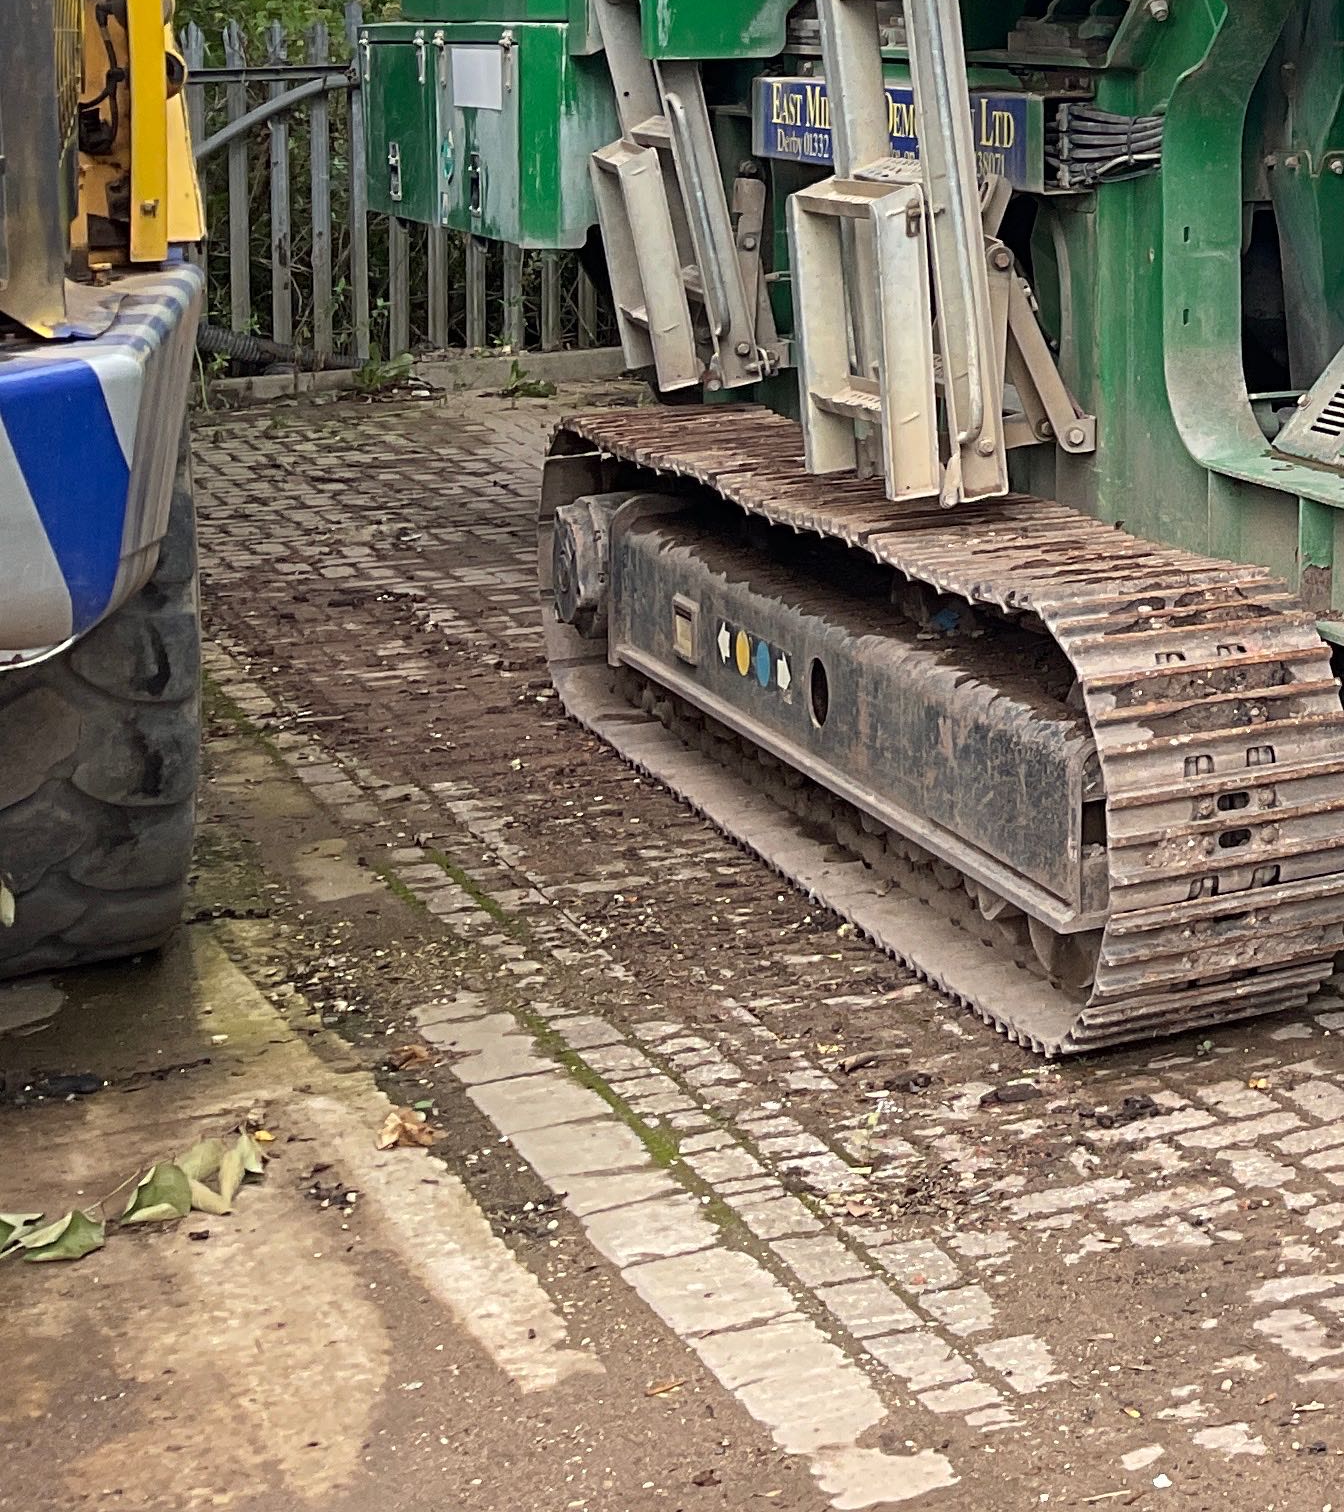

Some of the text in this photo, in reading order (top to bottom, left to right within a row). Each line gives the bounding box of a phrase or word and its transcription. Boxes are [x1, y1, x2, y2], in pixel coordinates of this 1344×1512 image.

[771, 82, 802, 125] EAST
[979, 98, 1015, 148] LTD
[777, 128, 801, 160] Derby
[803, 131, 829, 158] 01332
